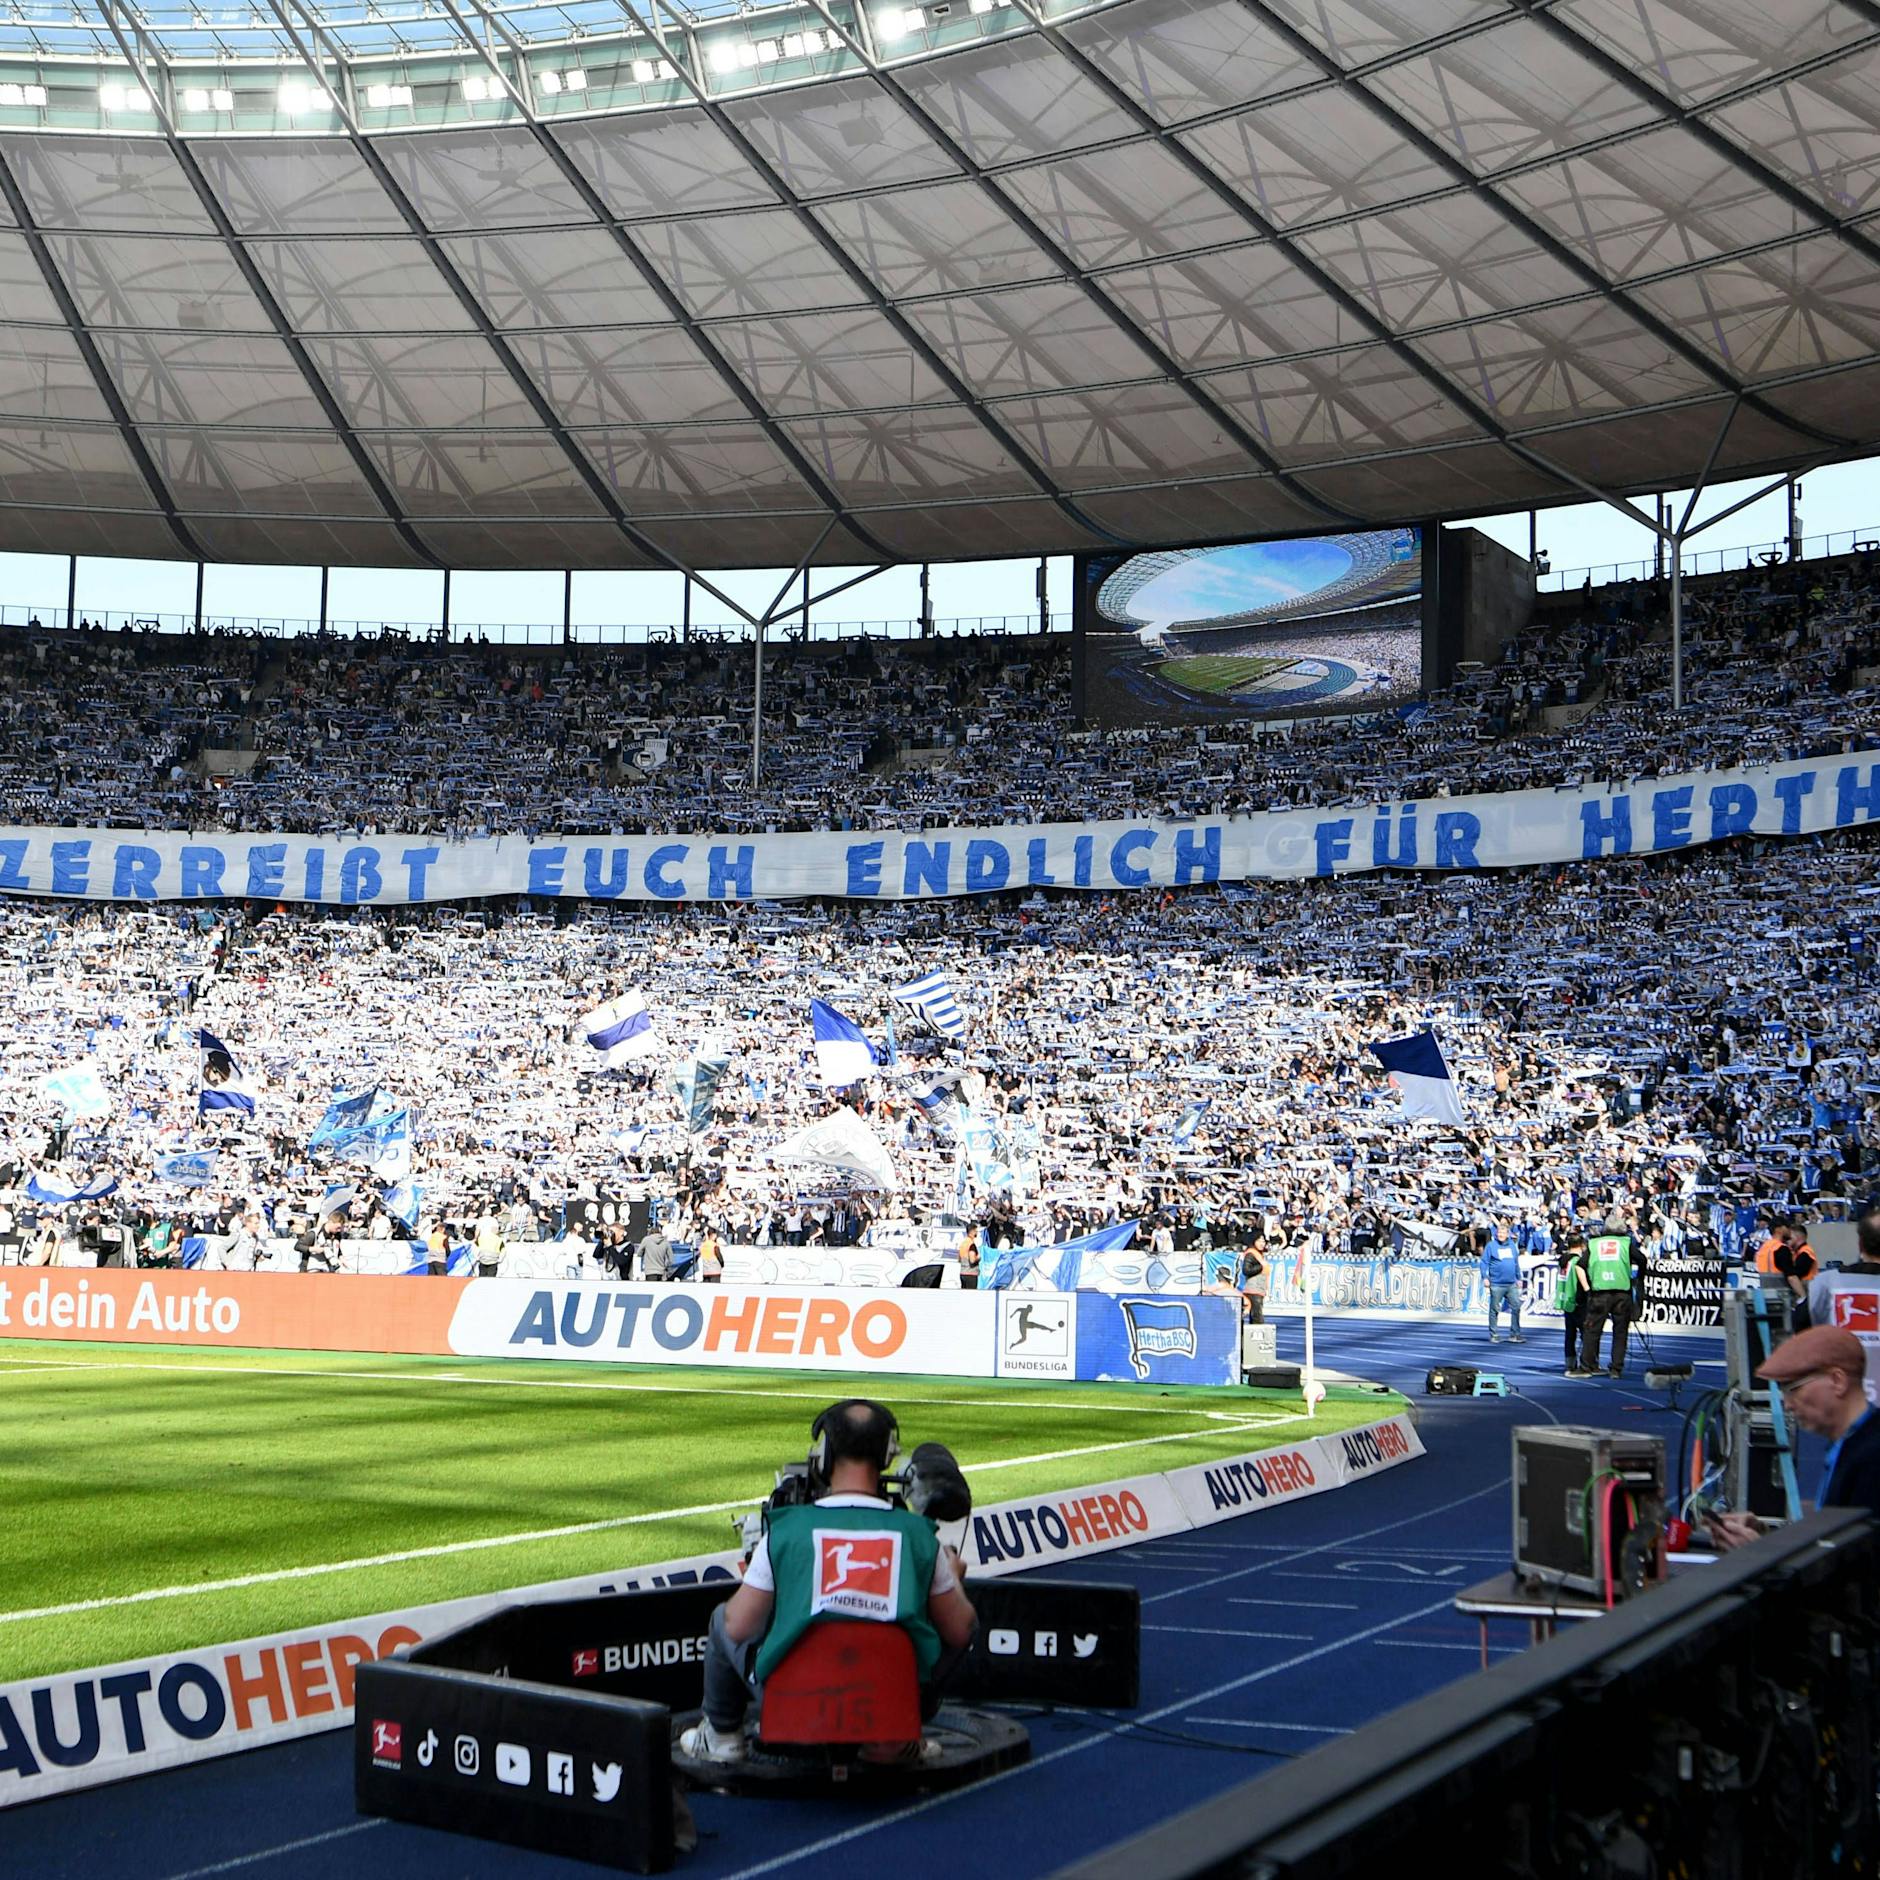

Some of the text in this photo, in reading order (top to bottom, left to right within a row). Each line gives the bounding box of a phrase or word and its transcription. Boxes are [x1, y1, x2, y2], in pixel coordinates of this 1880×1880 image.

[0, 839, 440, 904] ZERREIßT
[527, 845, 755, 898] EUCH
[846, 826, 1221, 897] ENDLICH
[1314, 803, 1481, 876] FÜR
[1643, 1275, 1721, 1300] HERMANN
[1655, 1260, 1706, 1273] GEDENKEN
[1706, 1261, 1722, 1273] AN
[23, 1278, 116, 1329] dein
[127, 1282, 240, 1334] Auto
[508, 1291, 908, 1359] AUTOHERO
[1004, 1360, 1068, 1372] BUNDESLIGA
[1347, 1420, 1411, 1471] AUTOHERO
[1204, 1451, 1316, 1511] AUTOHERO
[973, 1490, 1148, 1565] AUTOHERO
